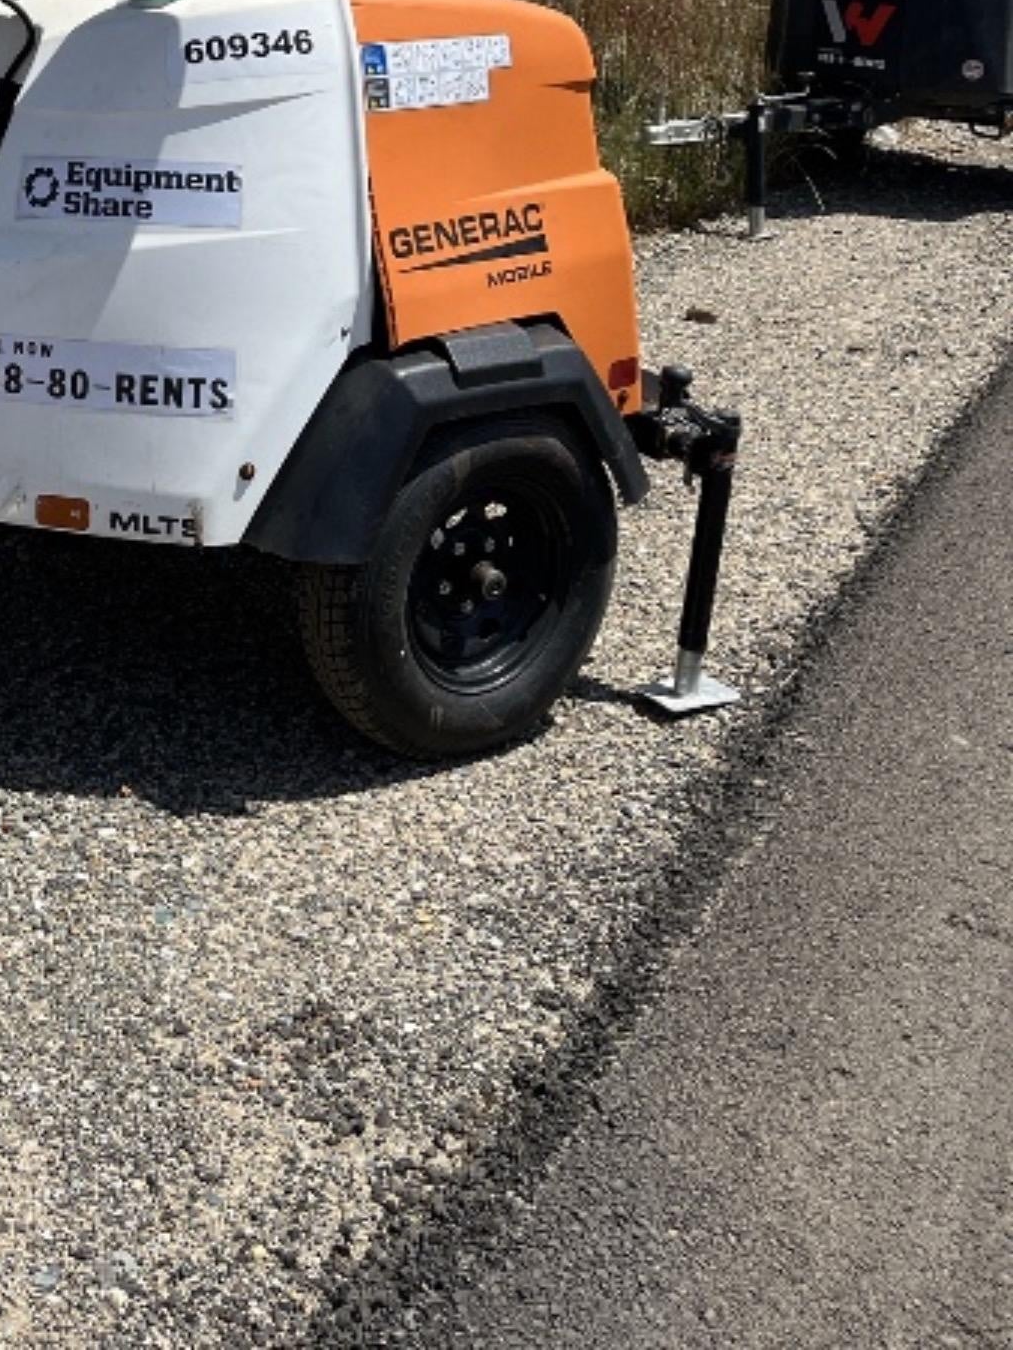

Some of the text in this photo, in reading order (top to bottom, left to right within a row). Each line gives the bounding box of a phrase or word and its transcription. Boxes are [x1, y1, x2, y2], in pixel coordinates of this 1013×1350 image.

[184, 29, 313, 64] 609346
[65, 161, 243, 194] Equipment
[63, 191, 153, 219] Share
[389, 203, 545, 259] GENERAC
